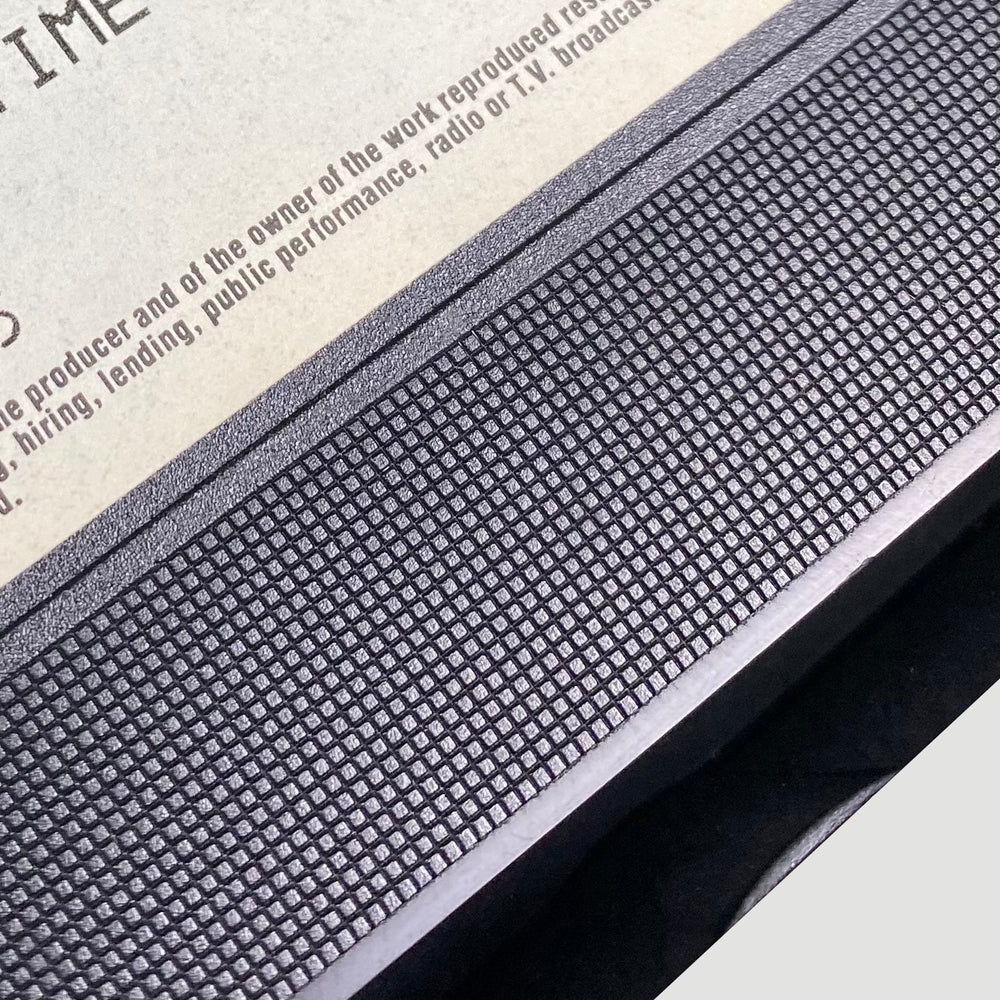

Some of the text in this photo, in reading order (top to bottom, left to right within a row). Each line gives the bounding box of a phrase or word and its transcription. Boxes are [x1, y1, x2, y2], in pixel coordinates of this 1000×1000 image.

[11, 392, 103, 456] hiring,
[96, 319, 203, 394] lending,
[200, 259, 277, 327] public
[274, 158, 428, 273] performance,
[424, 112, 486, 161] radio
[482, 89, 512, 119] or
[505, 59, 556, 98] T.V.
[23, 318, 132, 413] producer
[132, 281, 180, 329] and
[179, 261, 207, 295] of
[202, 238, 247, 275] the
[247, 186, 318, 246] owner
[318, 163, 345, 196] of
[339, 142, 383, 178] the
[380, 101, 441, 150] work
[436, 12, 561, 112] reproduced
